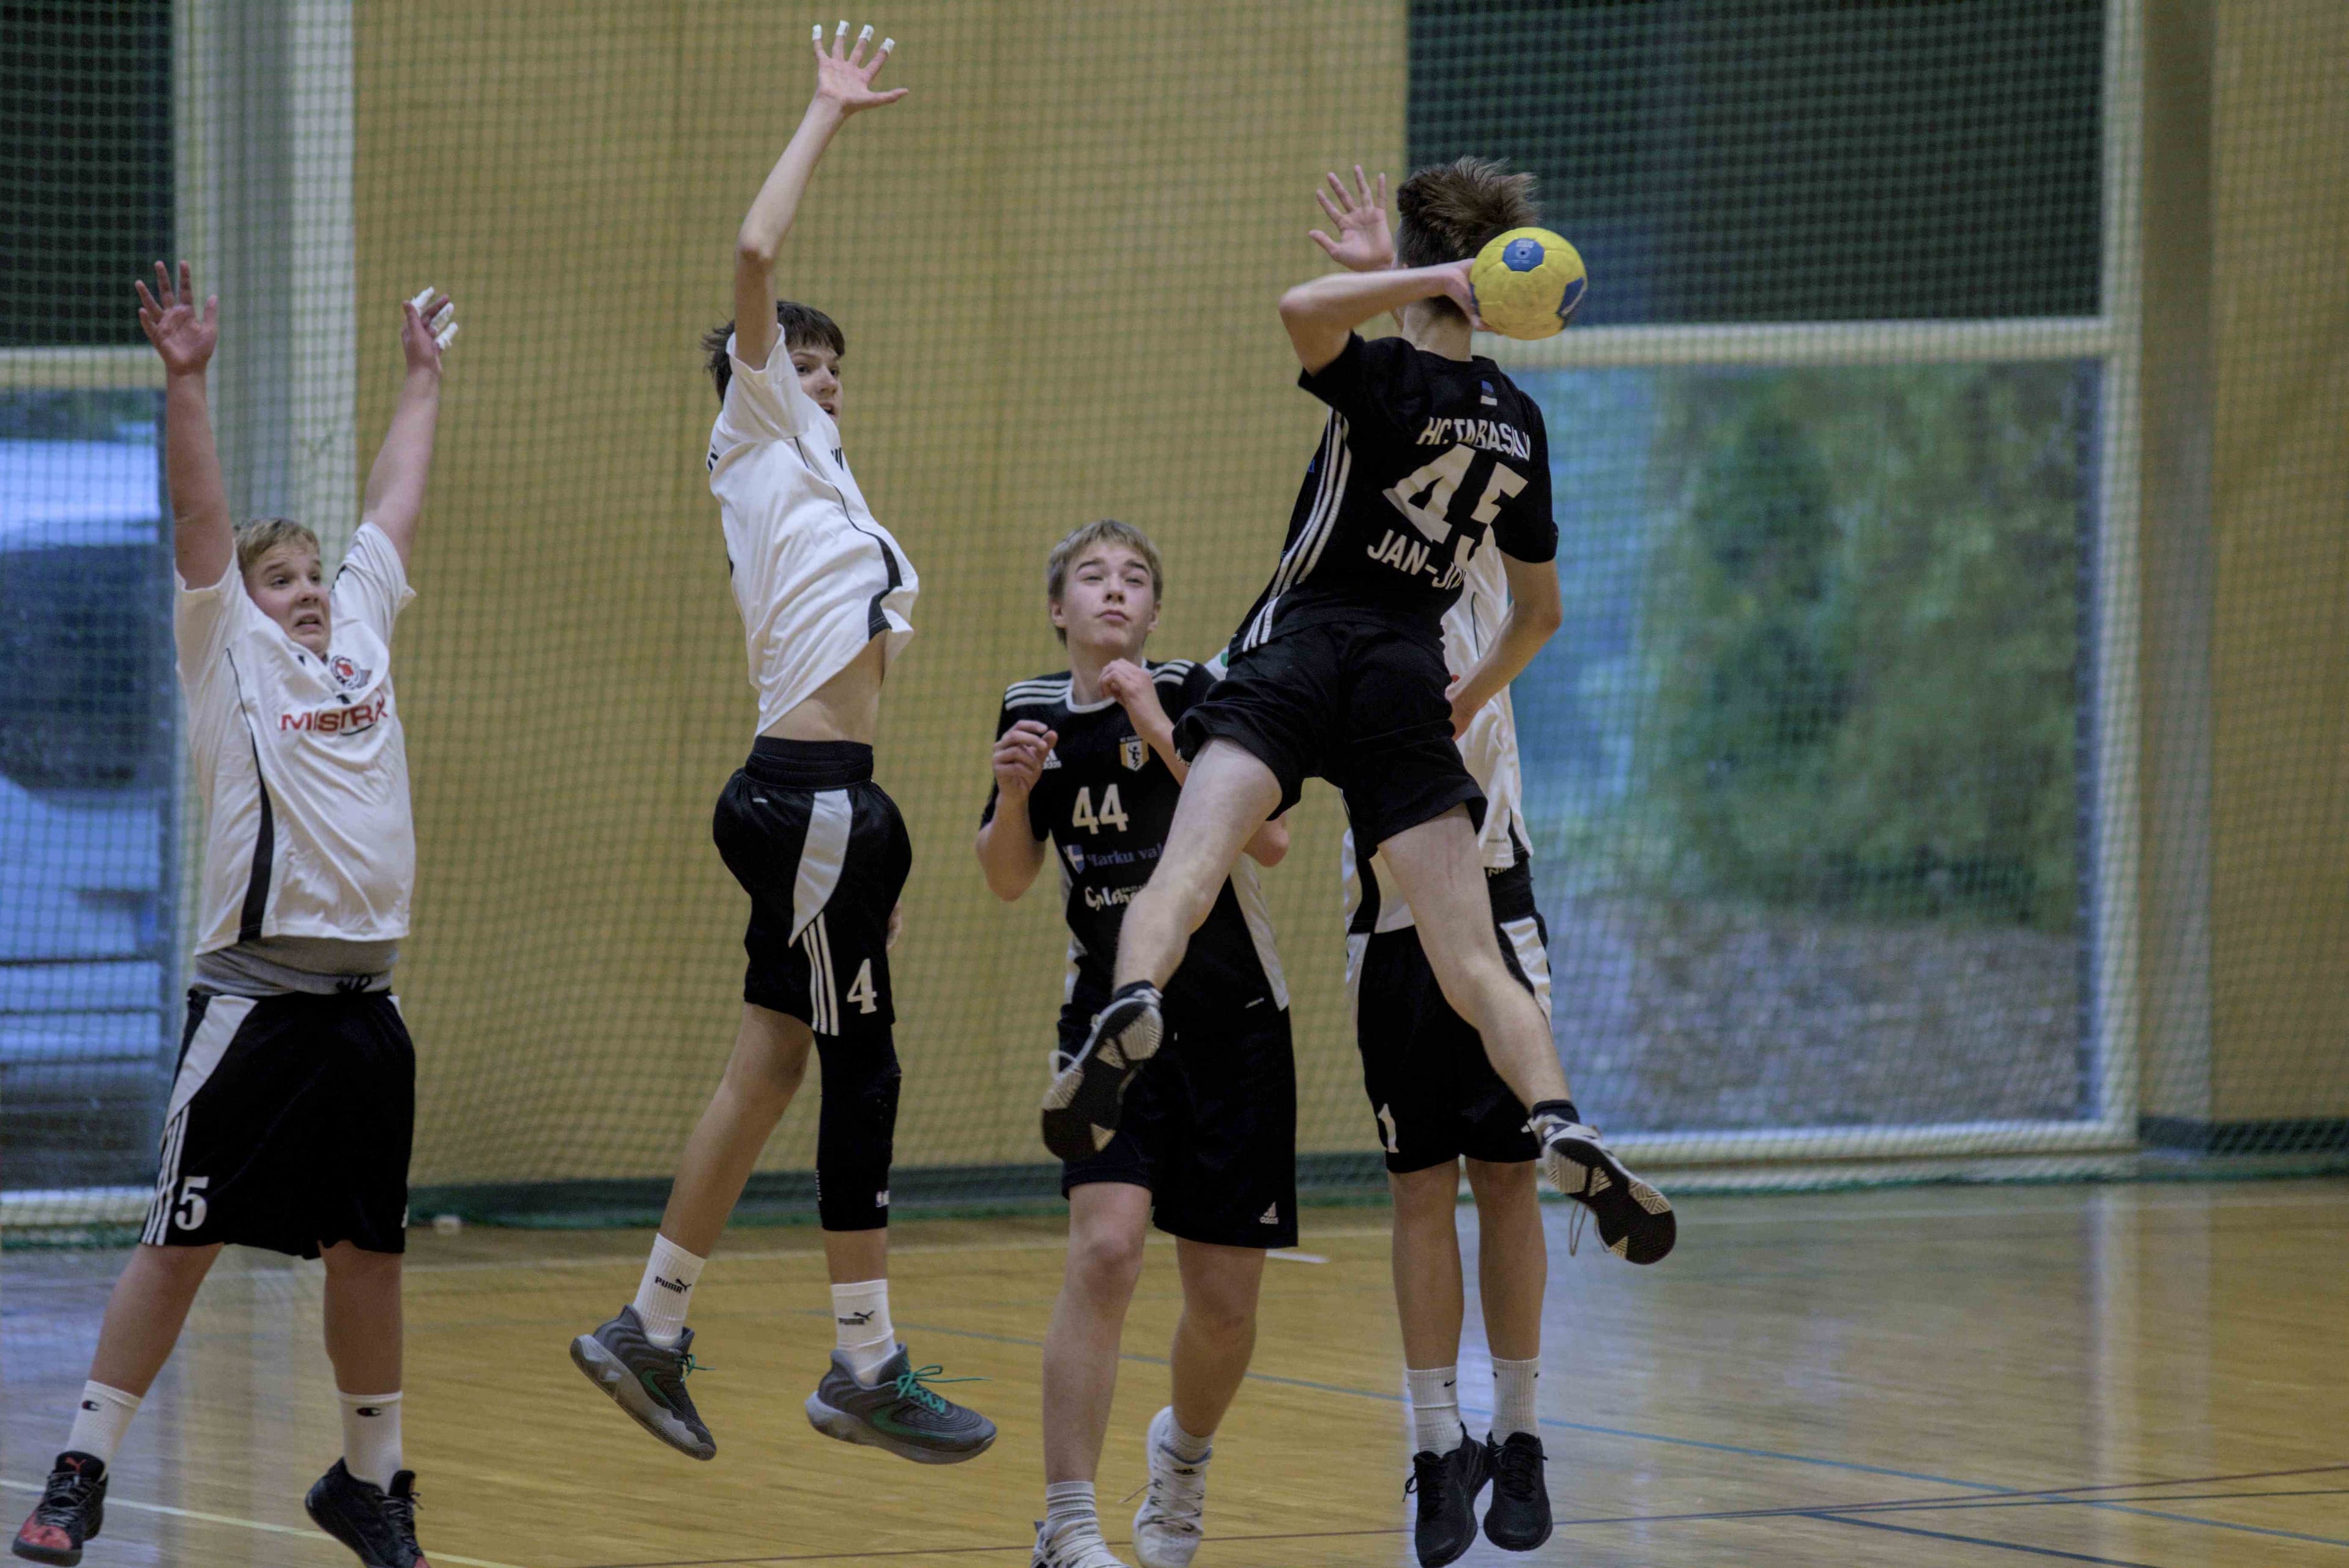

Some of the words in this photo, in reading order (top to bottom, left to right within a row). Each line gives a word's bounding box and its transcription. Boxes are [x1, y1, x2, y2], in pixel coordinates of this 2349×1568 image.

[1072, 783, 1129, 835] 44
[1138, 842, 1163, 860] val
[847, 958, 877, 1014] 4
[175, 1175, 209, 1231] 5
[655, 1276, 682, 1293] PUMA
